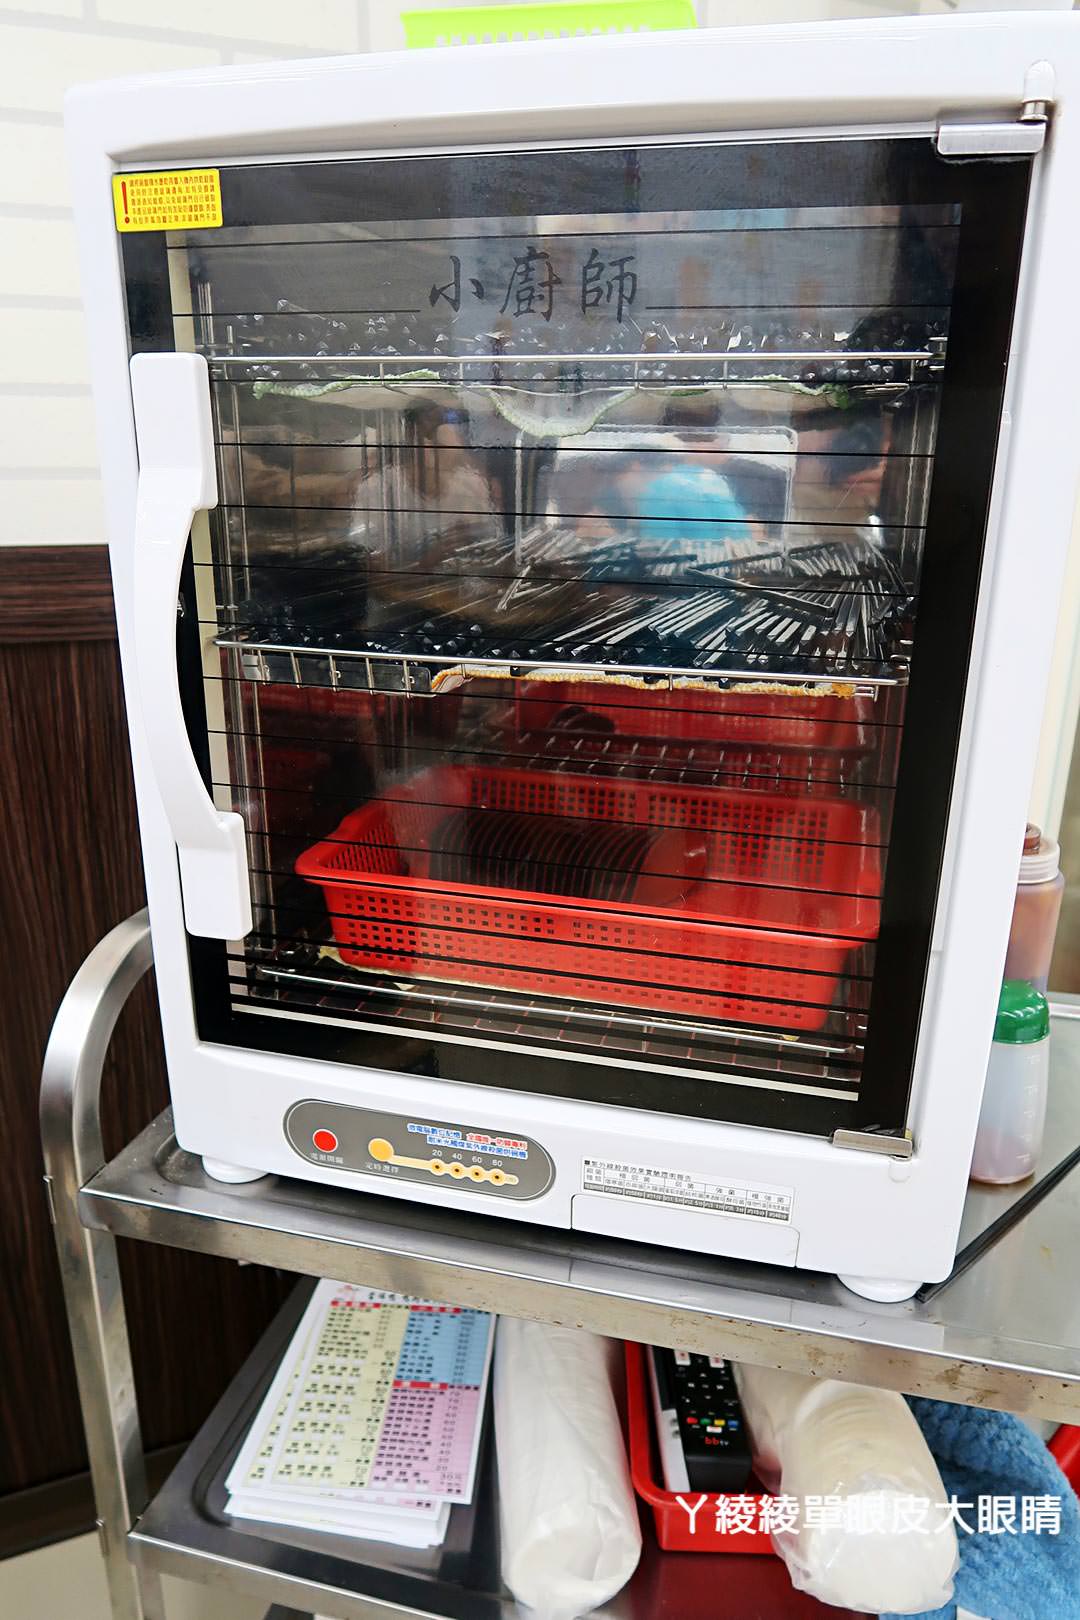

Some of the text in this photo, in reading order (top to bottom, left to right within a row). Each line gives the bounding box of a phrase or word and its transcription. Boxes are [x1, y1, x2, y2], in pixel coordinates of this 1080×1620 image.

[429, 246, 638, 323] 小廚師
[432, 1149, 443, 1157] 20
[452, 1152, 462, 1160] 40
